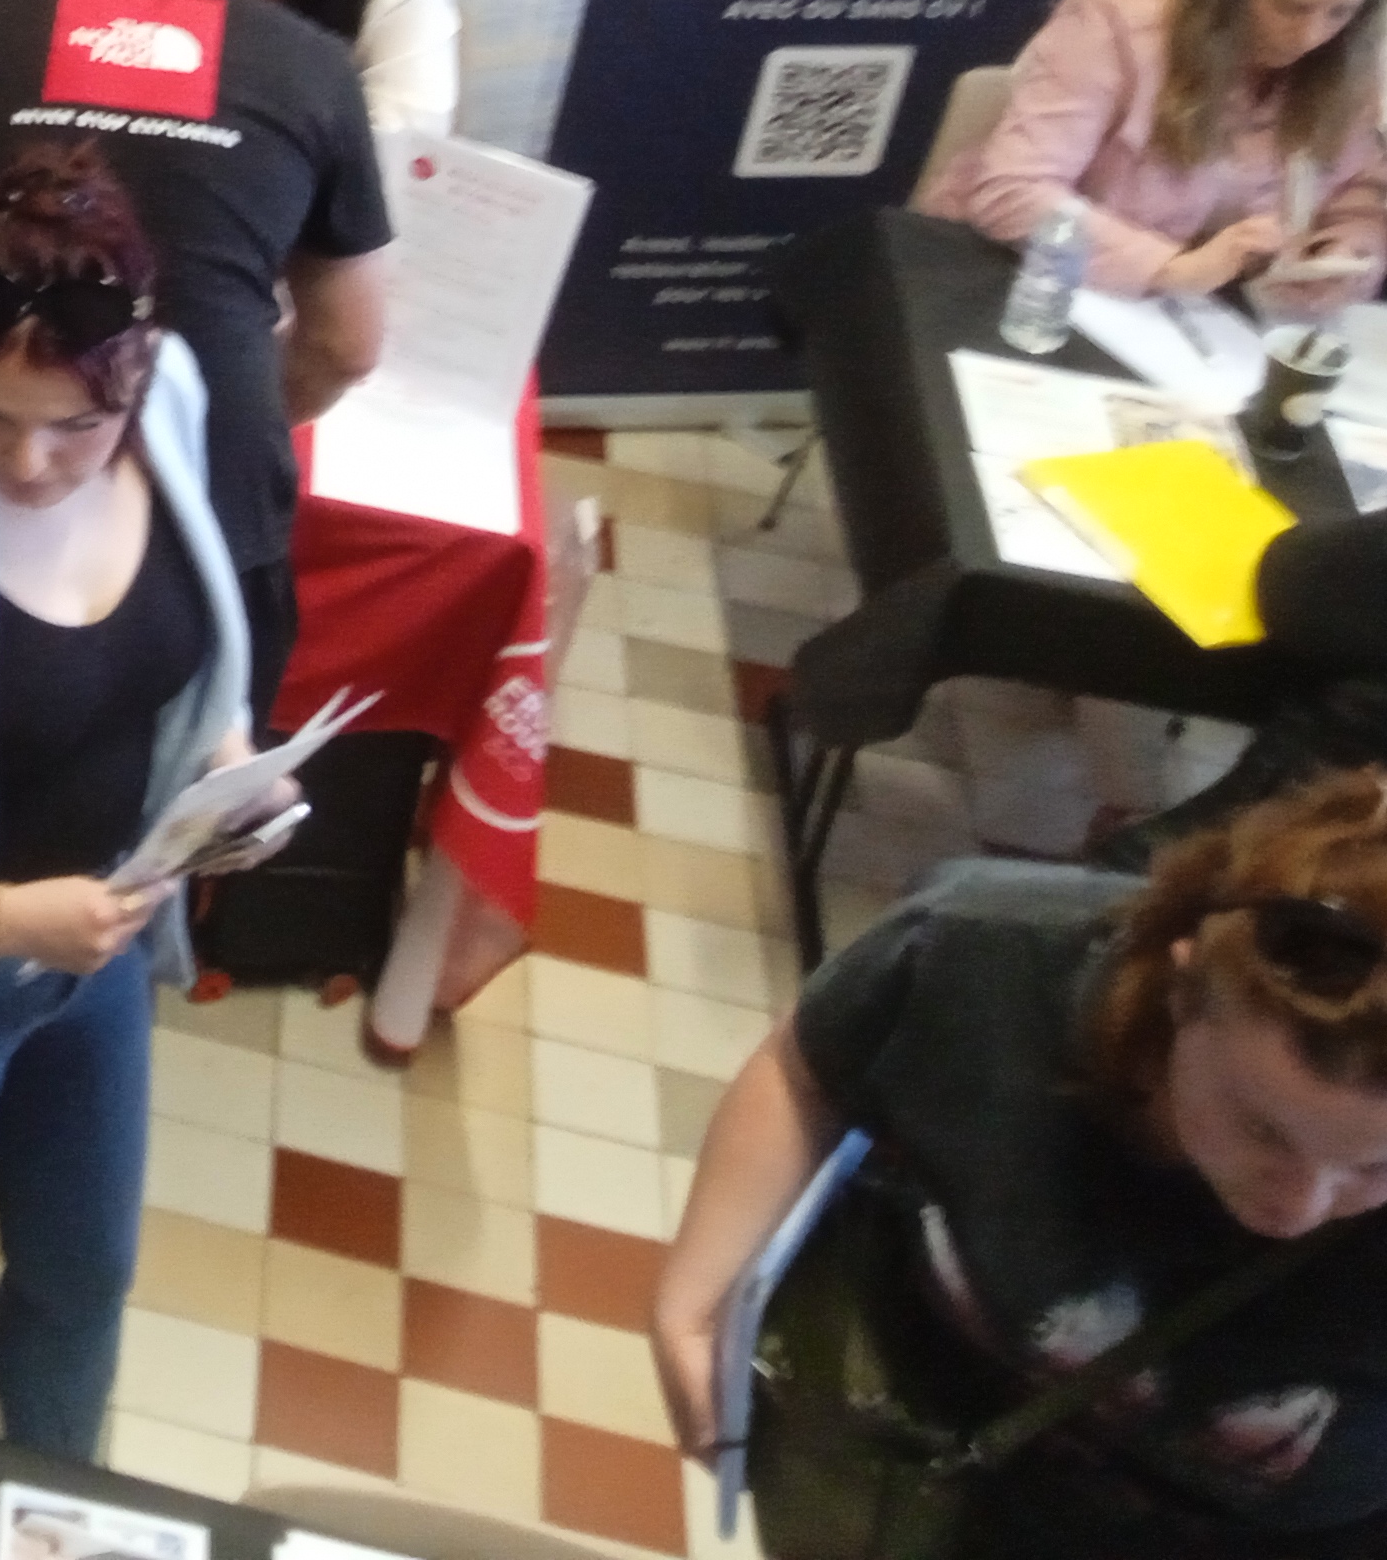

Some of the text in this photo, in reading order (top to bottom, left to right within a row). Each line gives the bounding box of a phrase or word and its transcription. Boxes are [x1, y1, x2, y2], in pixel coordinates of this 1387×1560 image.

[10, 107, 243, 149] NEVER STOP EXPLORING
